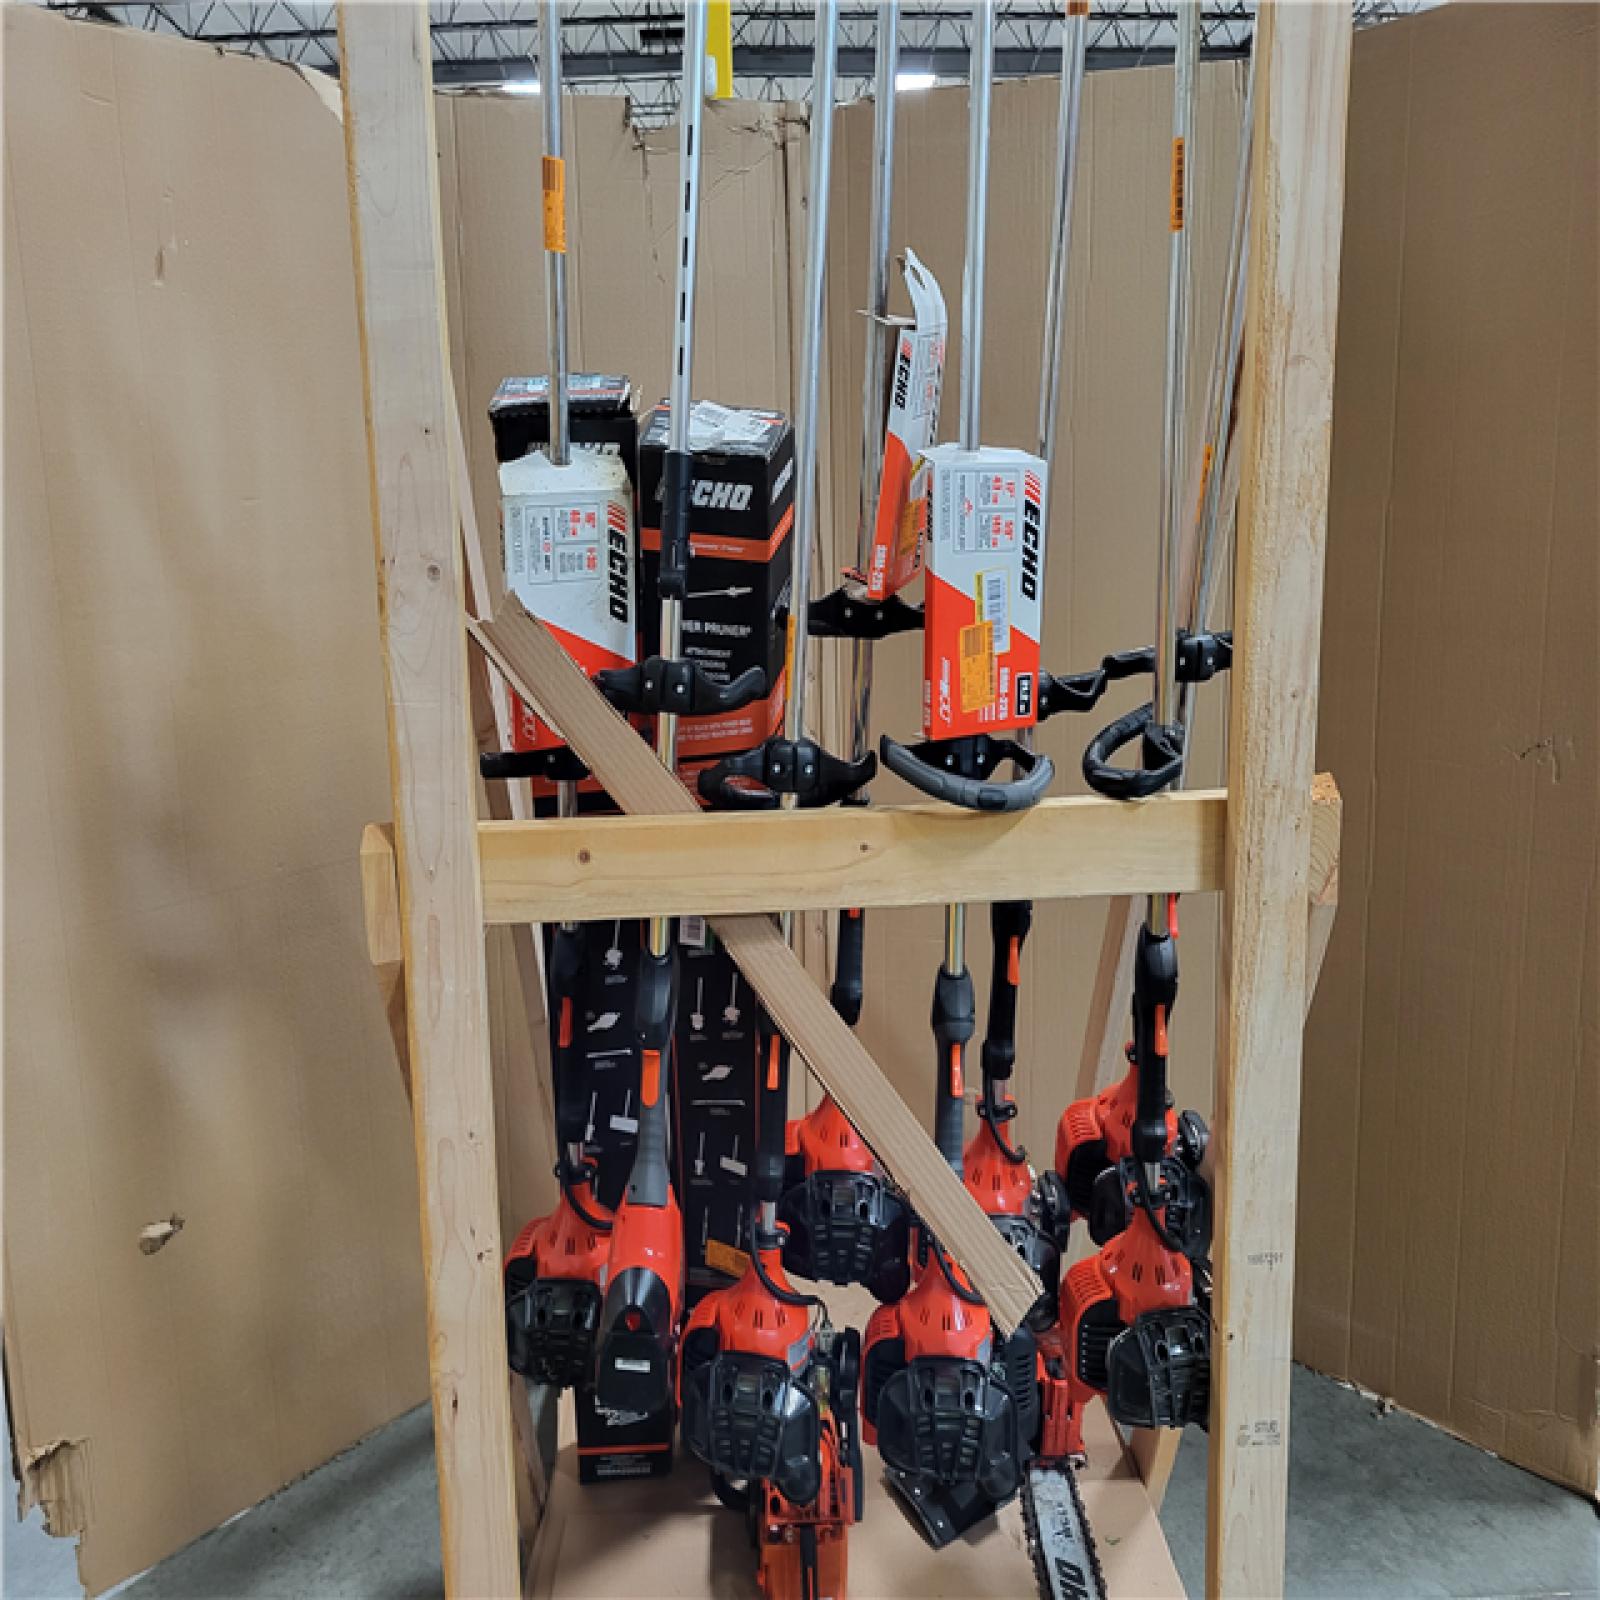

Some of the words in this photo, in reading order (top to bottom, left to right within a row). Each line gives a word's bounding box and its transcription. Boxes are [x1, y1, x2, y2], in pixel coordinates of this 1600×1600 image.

[894, 353, 911, 411] ECHO
[690, 478, 753, 511] CHO
[608, 528, 628, 624] ECHO
[1022, 499, 1041, 601] ECHO
